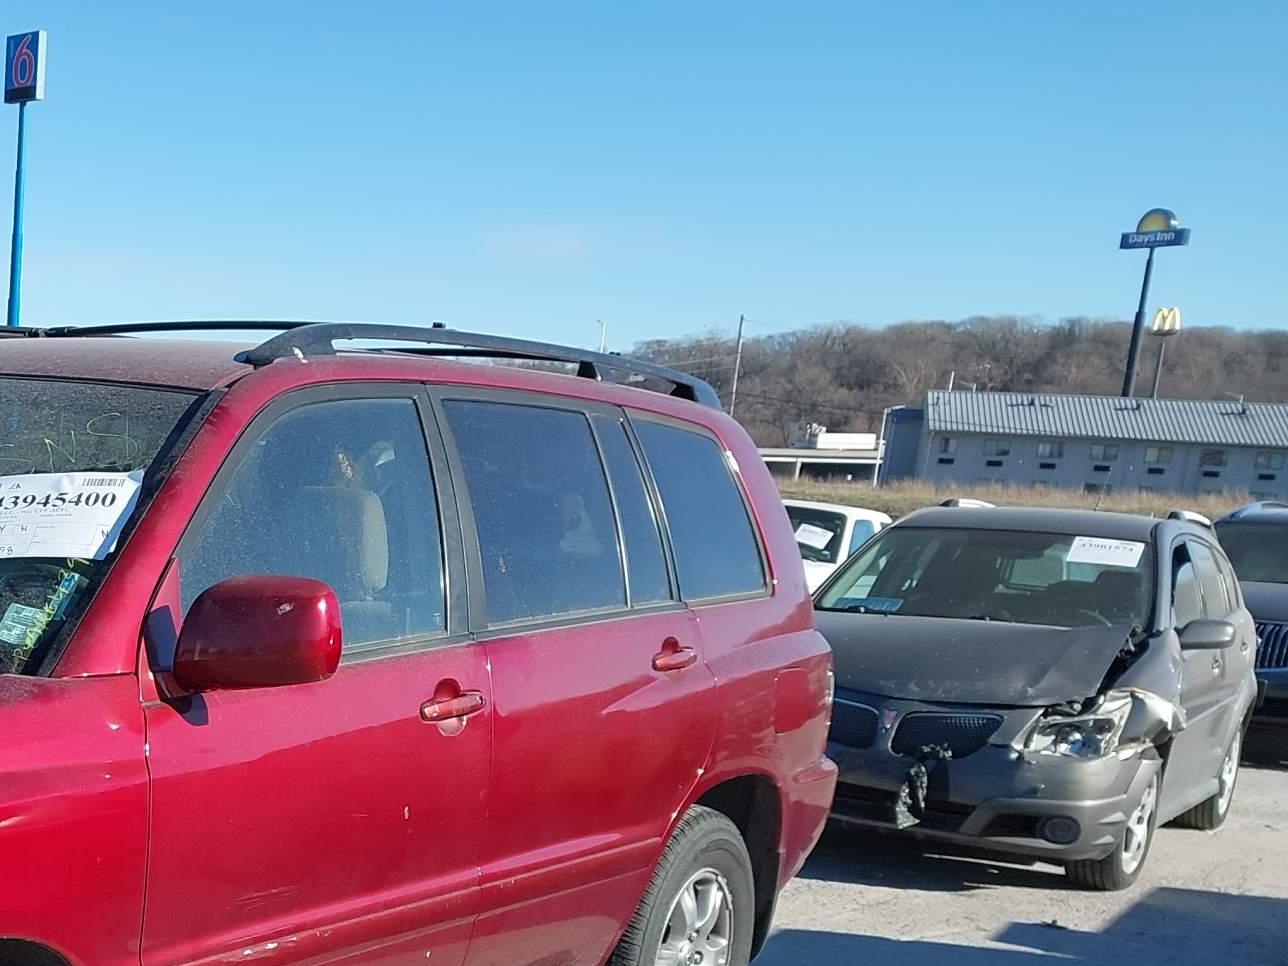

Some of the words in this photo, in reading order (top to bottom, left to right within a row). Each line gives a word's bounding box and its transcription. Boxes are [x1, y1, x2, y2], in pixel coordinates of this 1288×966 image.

[12, 34, 34, 88] 6
[1128, 233, 1155, 244] Days
[1156, 232, 1175, 241] Inn
